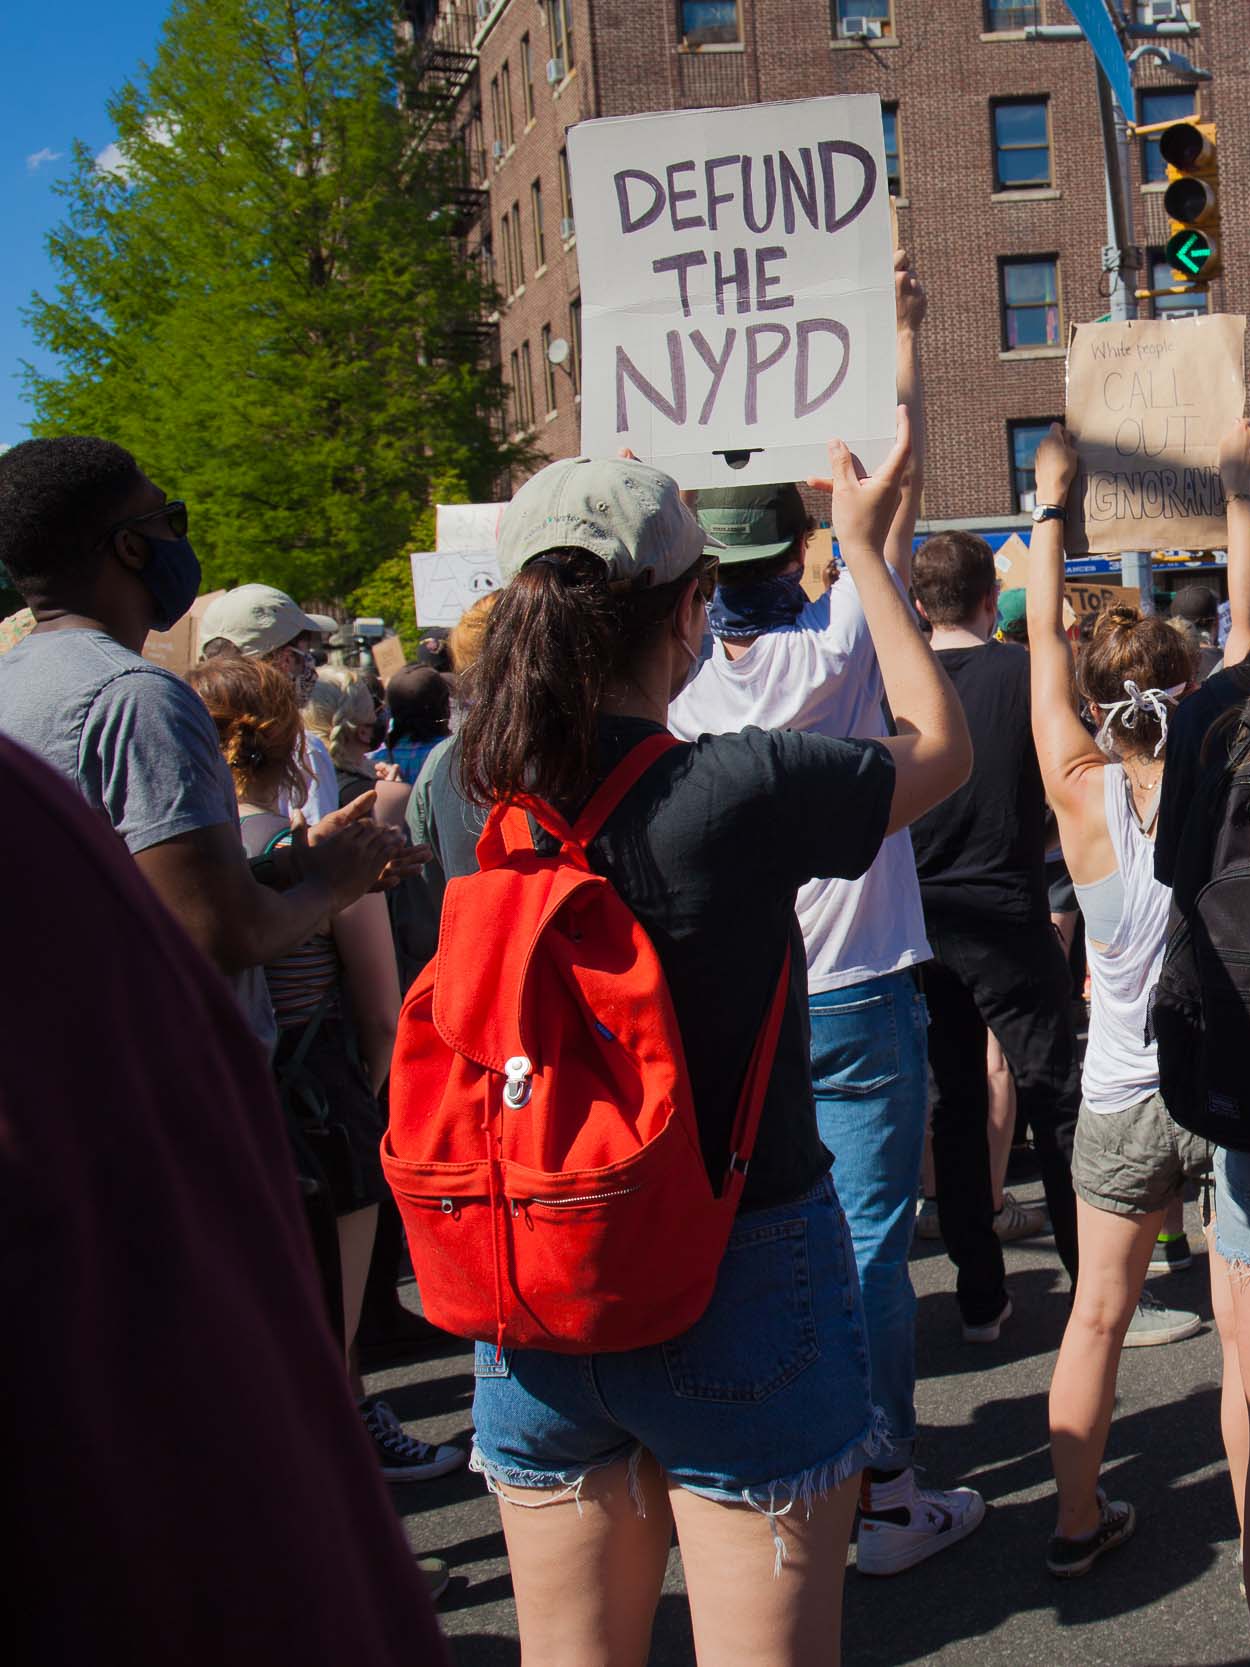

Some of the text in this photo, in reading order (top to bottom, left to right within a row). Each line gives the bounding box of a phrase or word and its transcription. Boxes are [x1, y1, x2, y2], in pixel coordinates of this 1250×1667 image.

[614, 140, 877, 235] DEFUND
[653, 246, 795, 318] THE
[616, 318, 851, 433] NYPD
[1091, 338, 1131, 360] White
[1104, 367, 1194, 411] CALL
[1115, 416, 1201, 458] OUT
